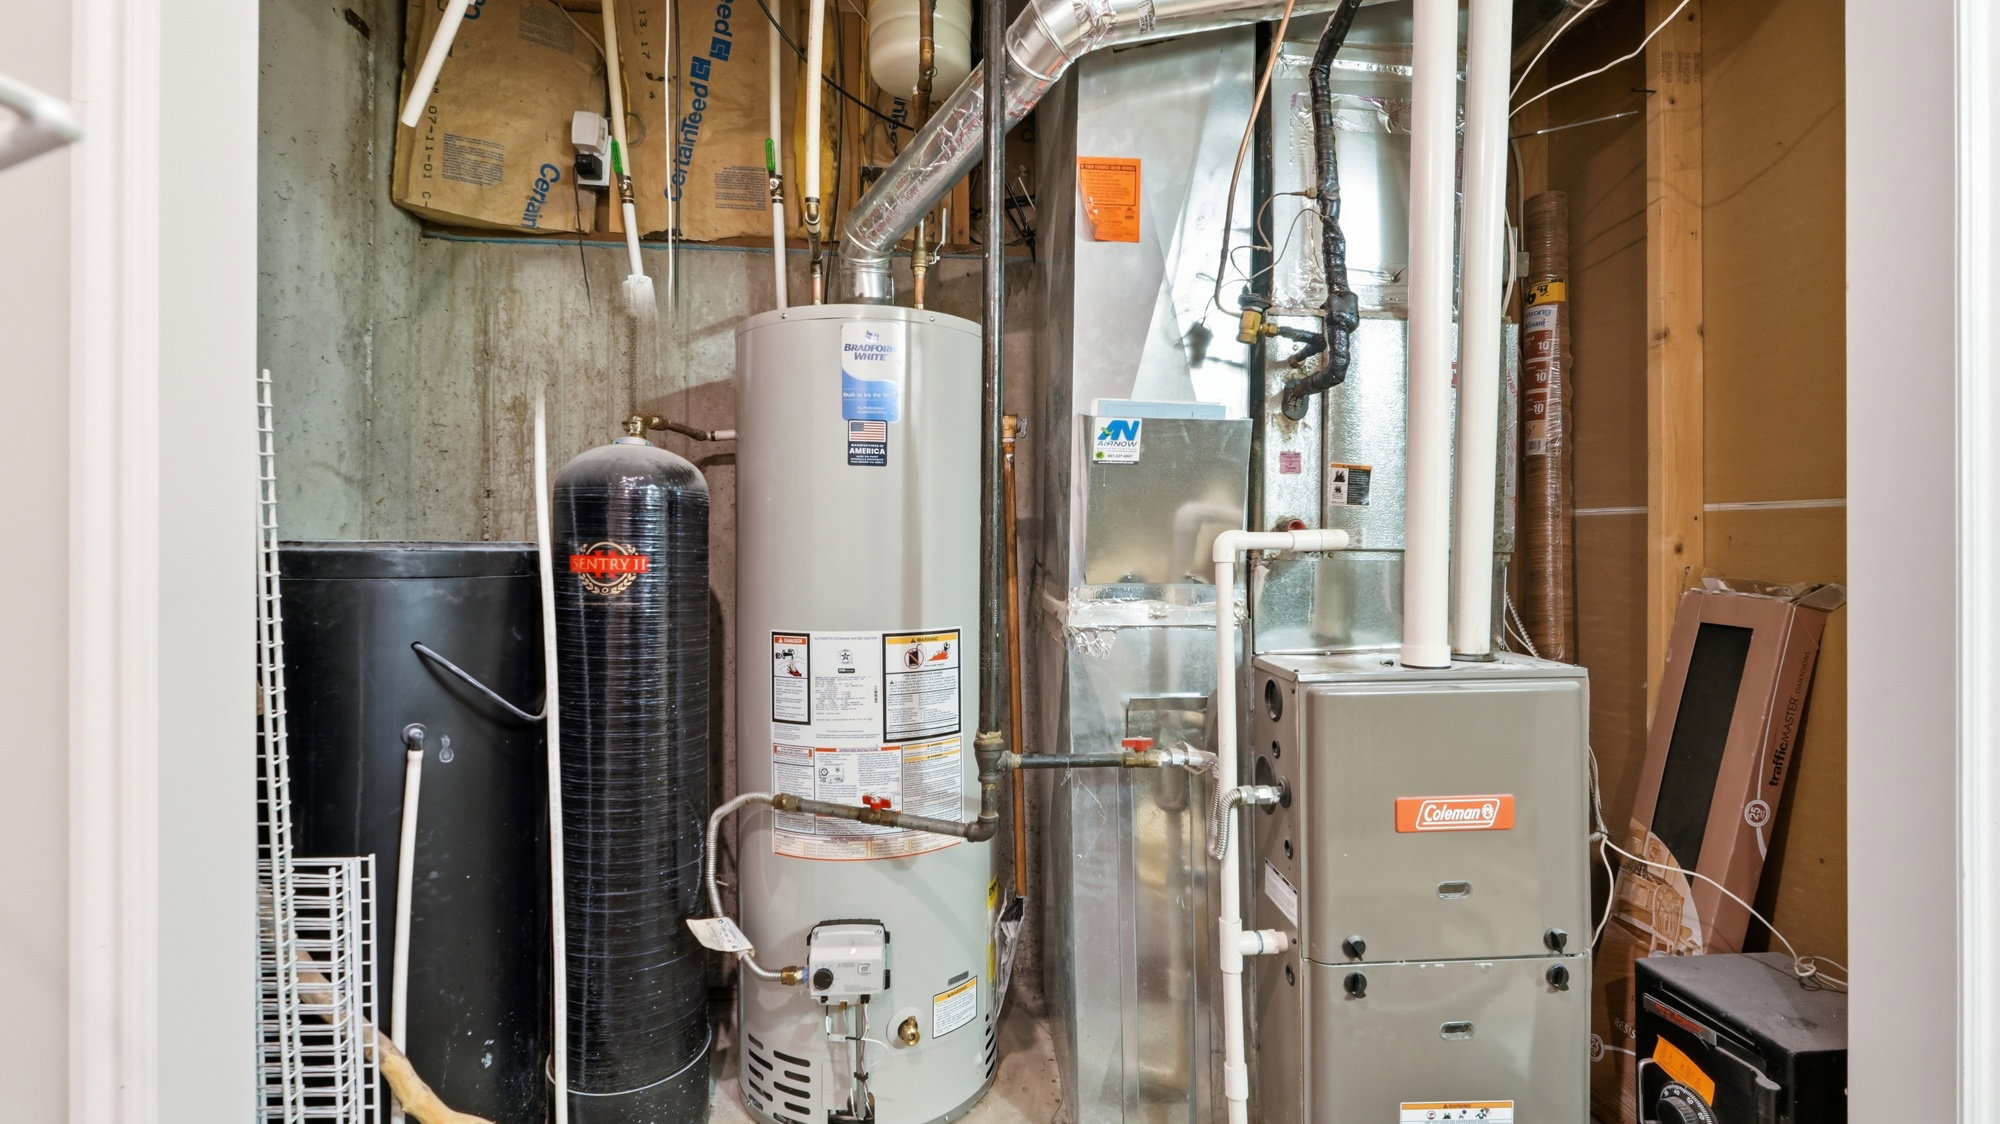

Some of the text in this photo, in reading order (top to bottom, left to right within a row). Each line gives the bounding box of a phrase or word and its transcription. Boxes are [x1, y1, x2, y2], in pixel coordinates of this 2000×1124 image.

[664, 81, 710, 202] CertainTeed
[1538, 341, 1549, 350] 10
[853, 353, 887, 361] WHITE
[1535, 372, 1546, 382] 10
[1532, 403, 1544, 413] 10
[849, 447, 886, 455] AMERICA
[573, 557, 646, 571] SENTRY II
[1768, 697, 1799, 787] trafficMASTER
[1424, 804, 1481, 822] Coleman
[1749, 806, 1761, 821] 25
